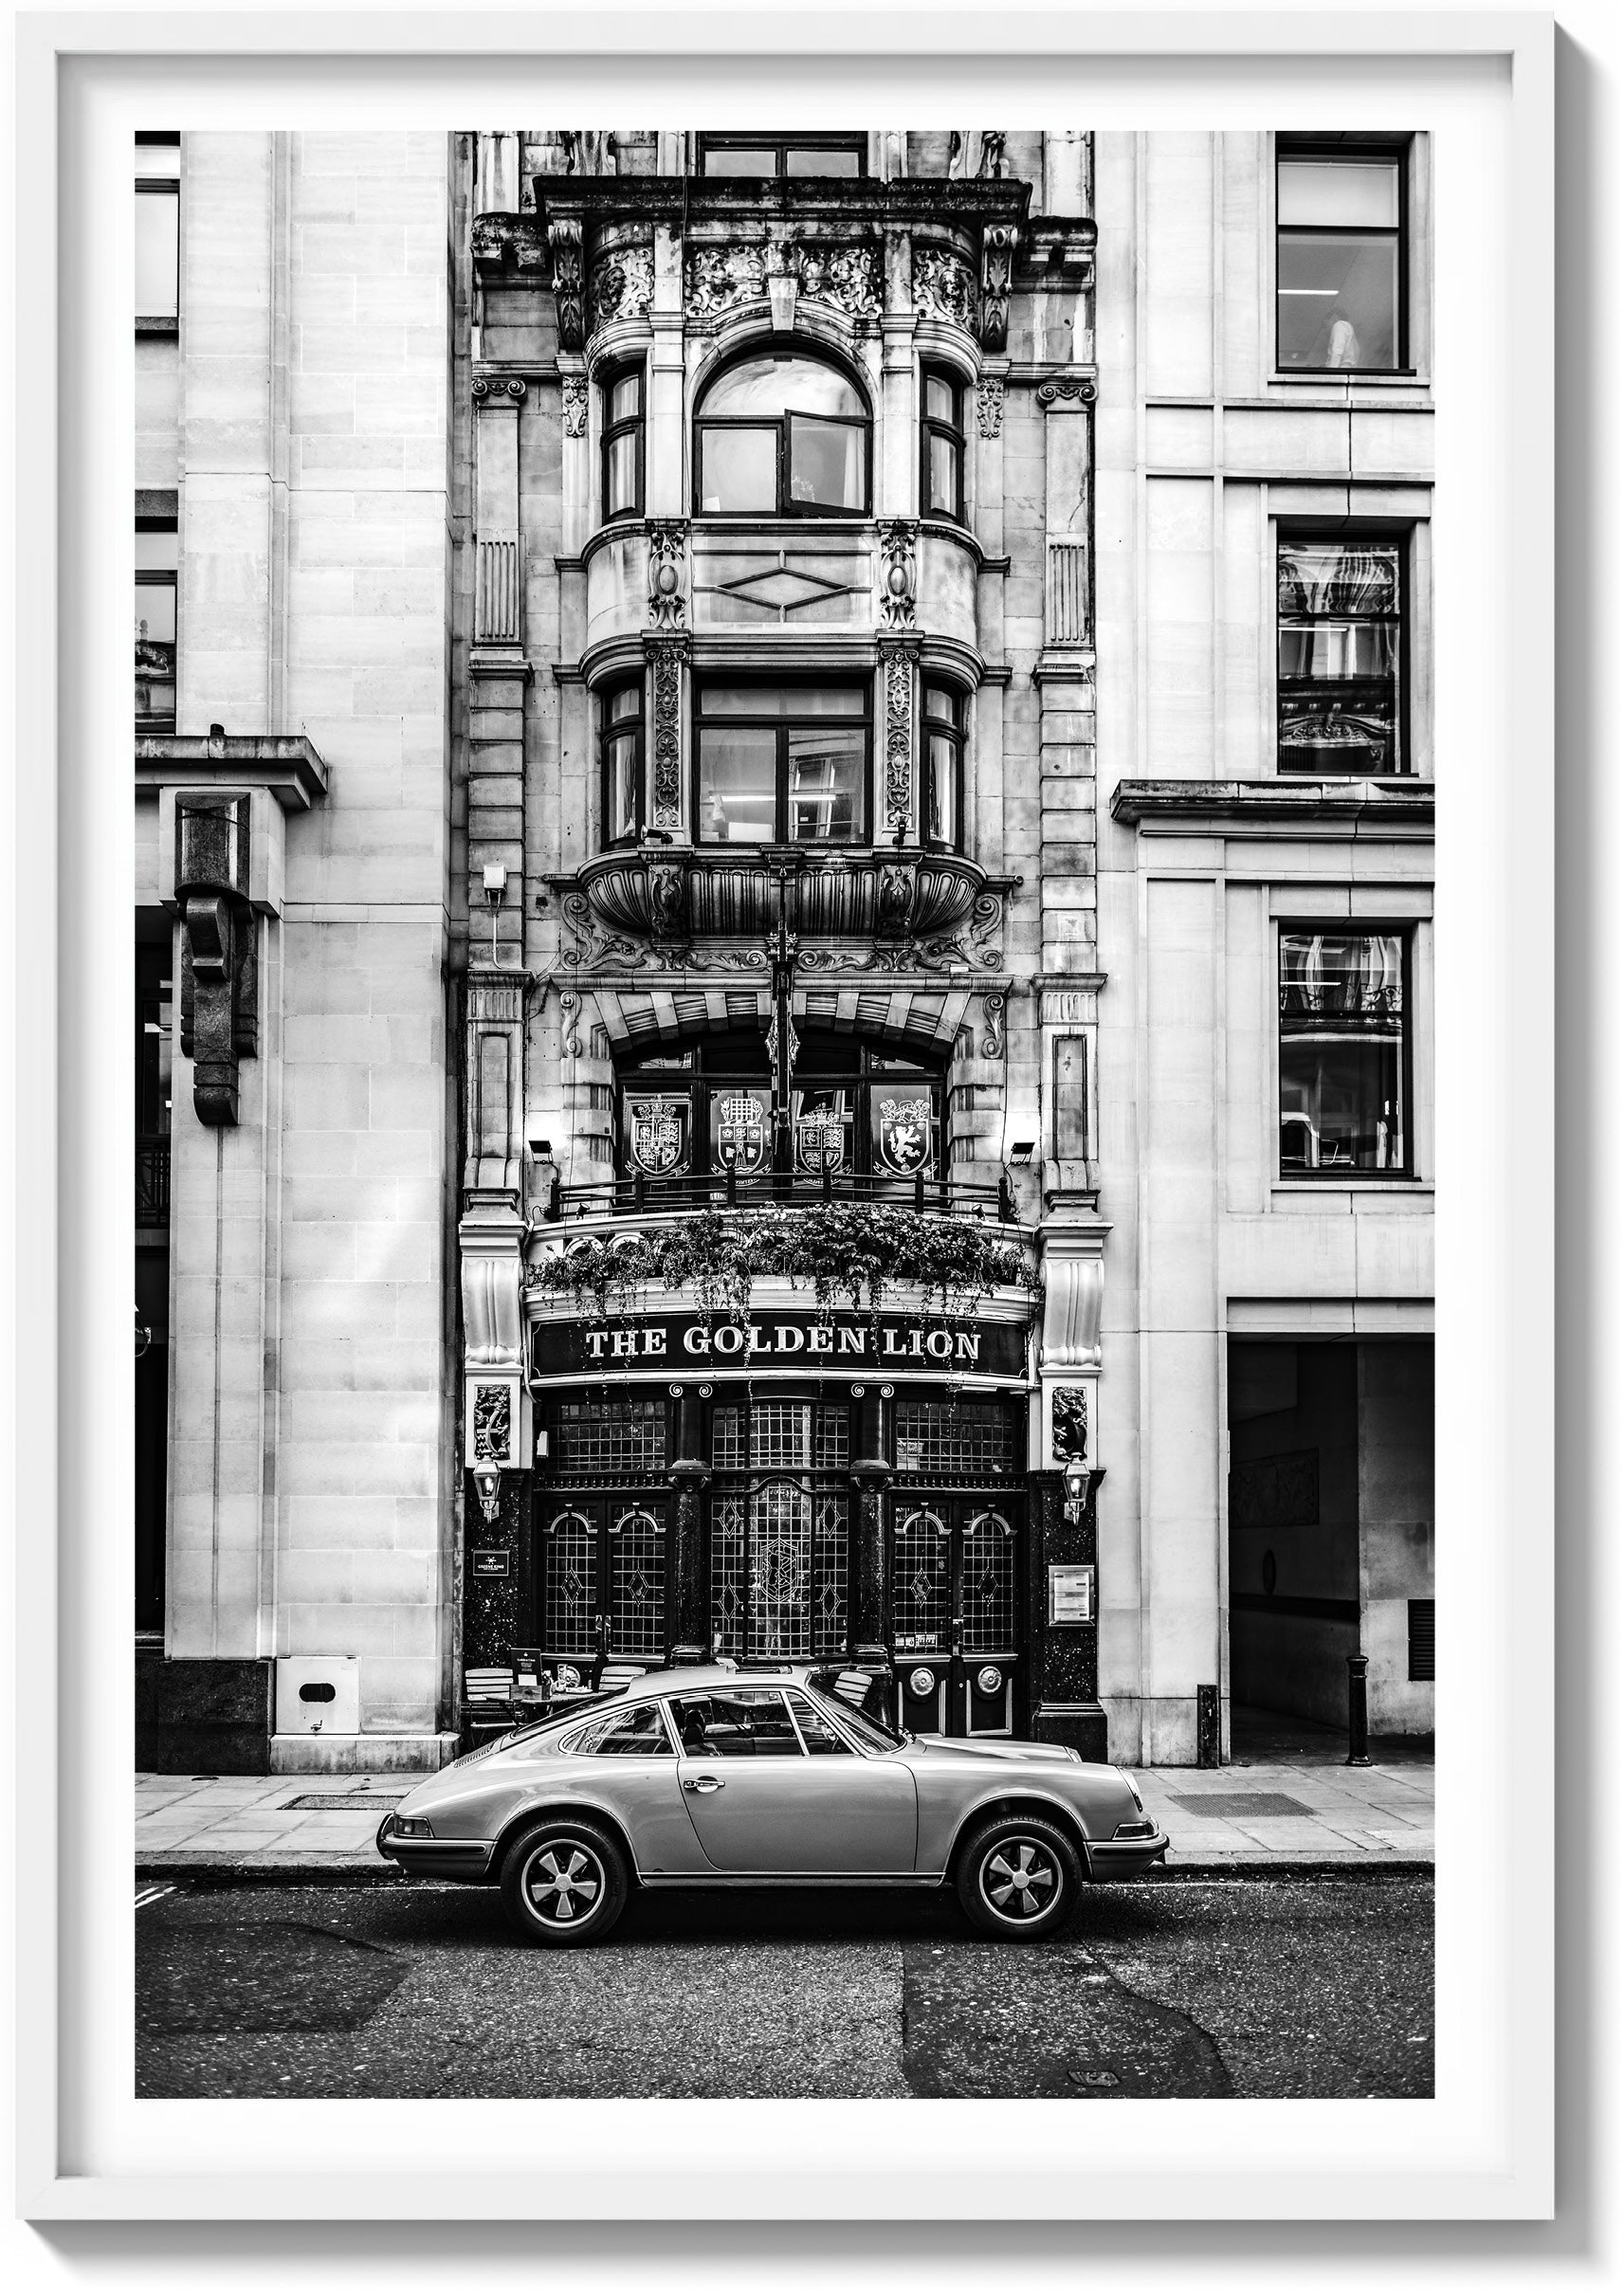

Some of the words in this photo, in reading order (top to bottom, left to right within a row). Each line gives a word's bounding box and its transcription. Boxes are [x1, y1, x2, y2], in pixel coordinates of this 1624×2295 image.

[585, 1327, 667, 1358] THE
[683, 1325, 868, 1355] GOLDEN
[883, 1328, 982, 1360] LION
